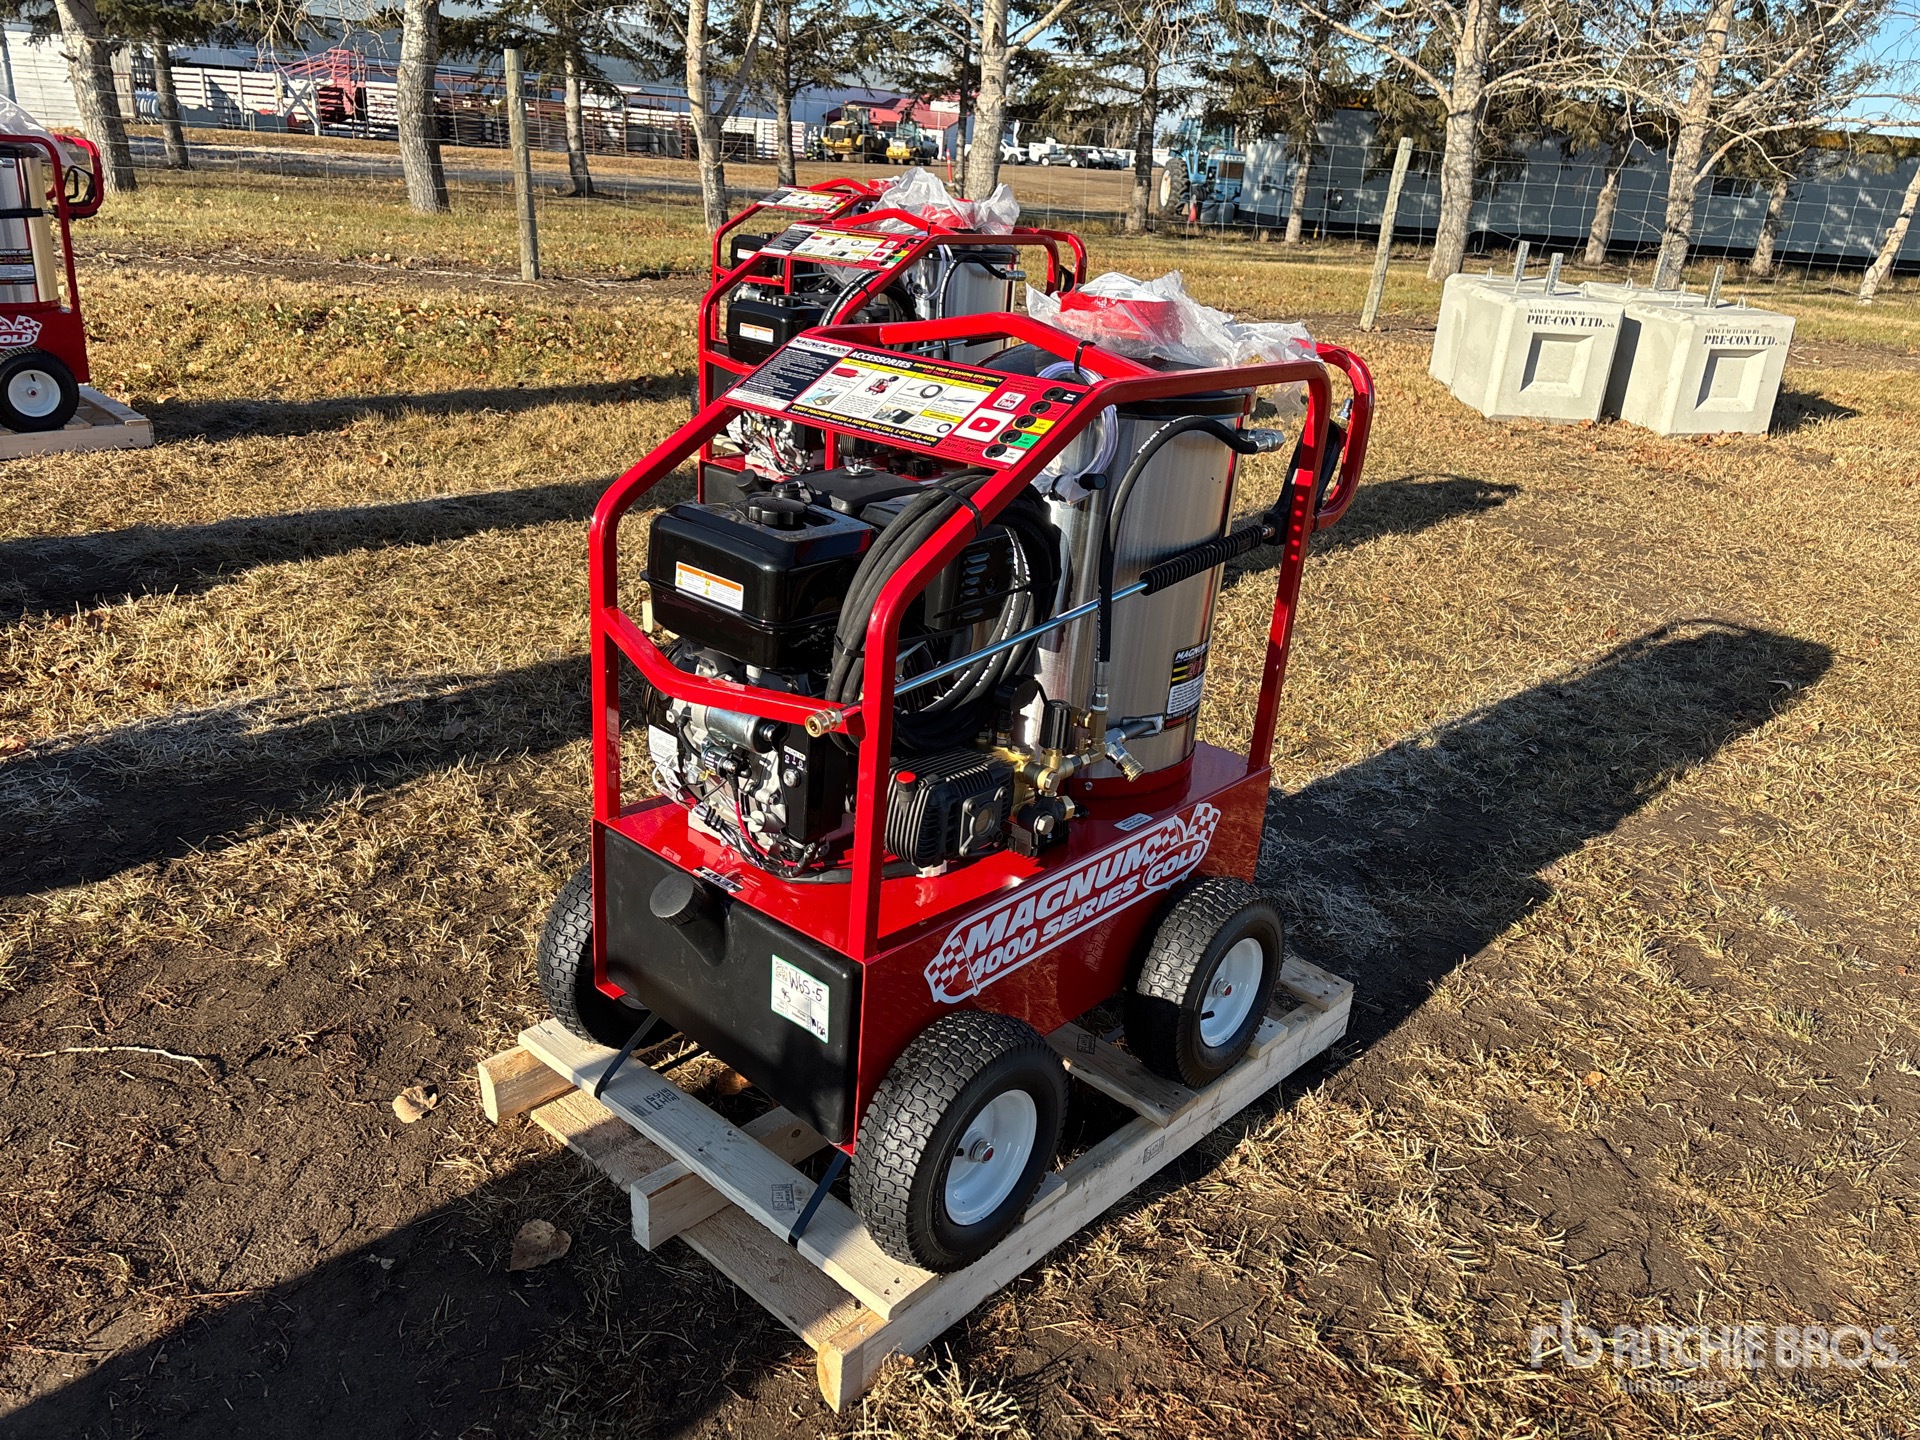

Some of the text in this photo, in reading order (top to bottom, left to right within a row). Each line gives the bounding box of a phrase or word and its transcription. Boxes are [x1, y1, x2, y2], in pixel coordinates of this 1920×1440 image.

[1527, 315, 1577, 326] PRE-CON
[1580, 317, 1606, 328] LTD.
[1704, 335, 1752, 346] PRE-CON
[1754, 336, 1778, 346] LTD.
[850, 352, 912, 369] ACCESSORIES
[972, 374, 1003, 382] EFFICIENCY
[806, 408, 831, 417] MACHINE
[941, 440, 958, 448] 7am
[962, 445, 981, 454] 4pm
[1149, 842, 1203, 882] GOLD
[963, 832, 1164, 952] MAGNUM
[968, 874, 1138, 982] 4000 SERIES
